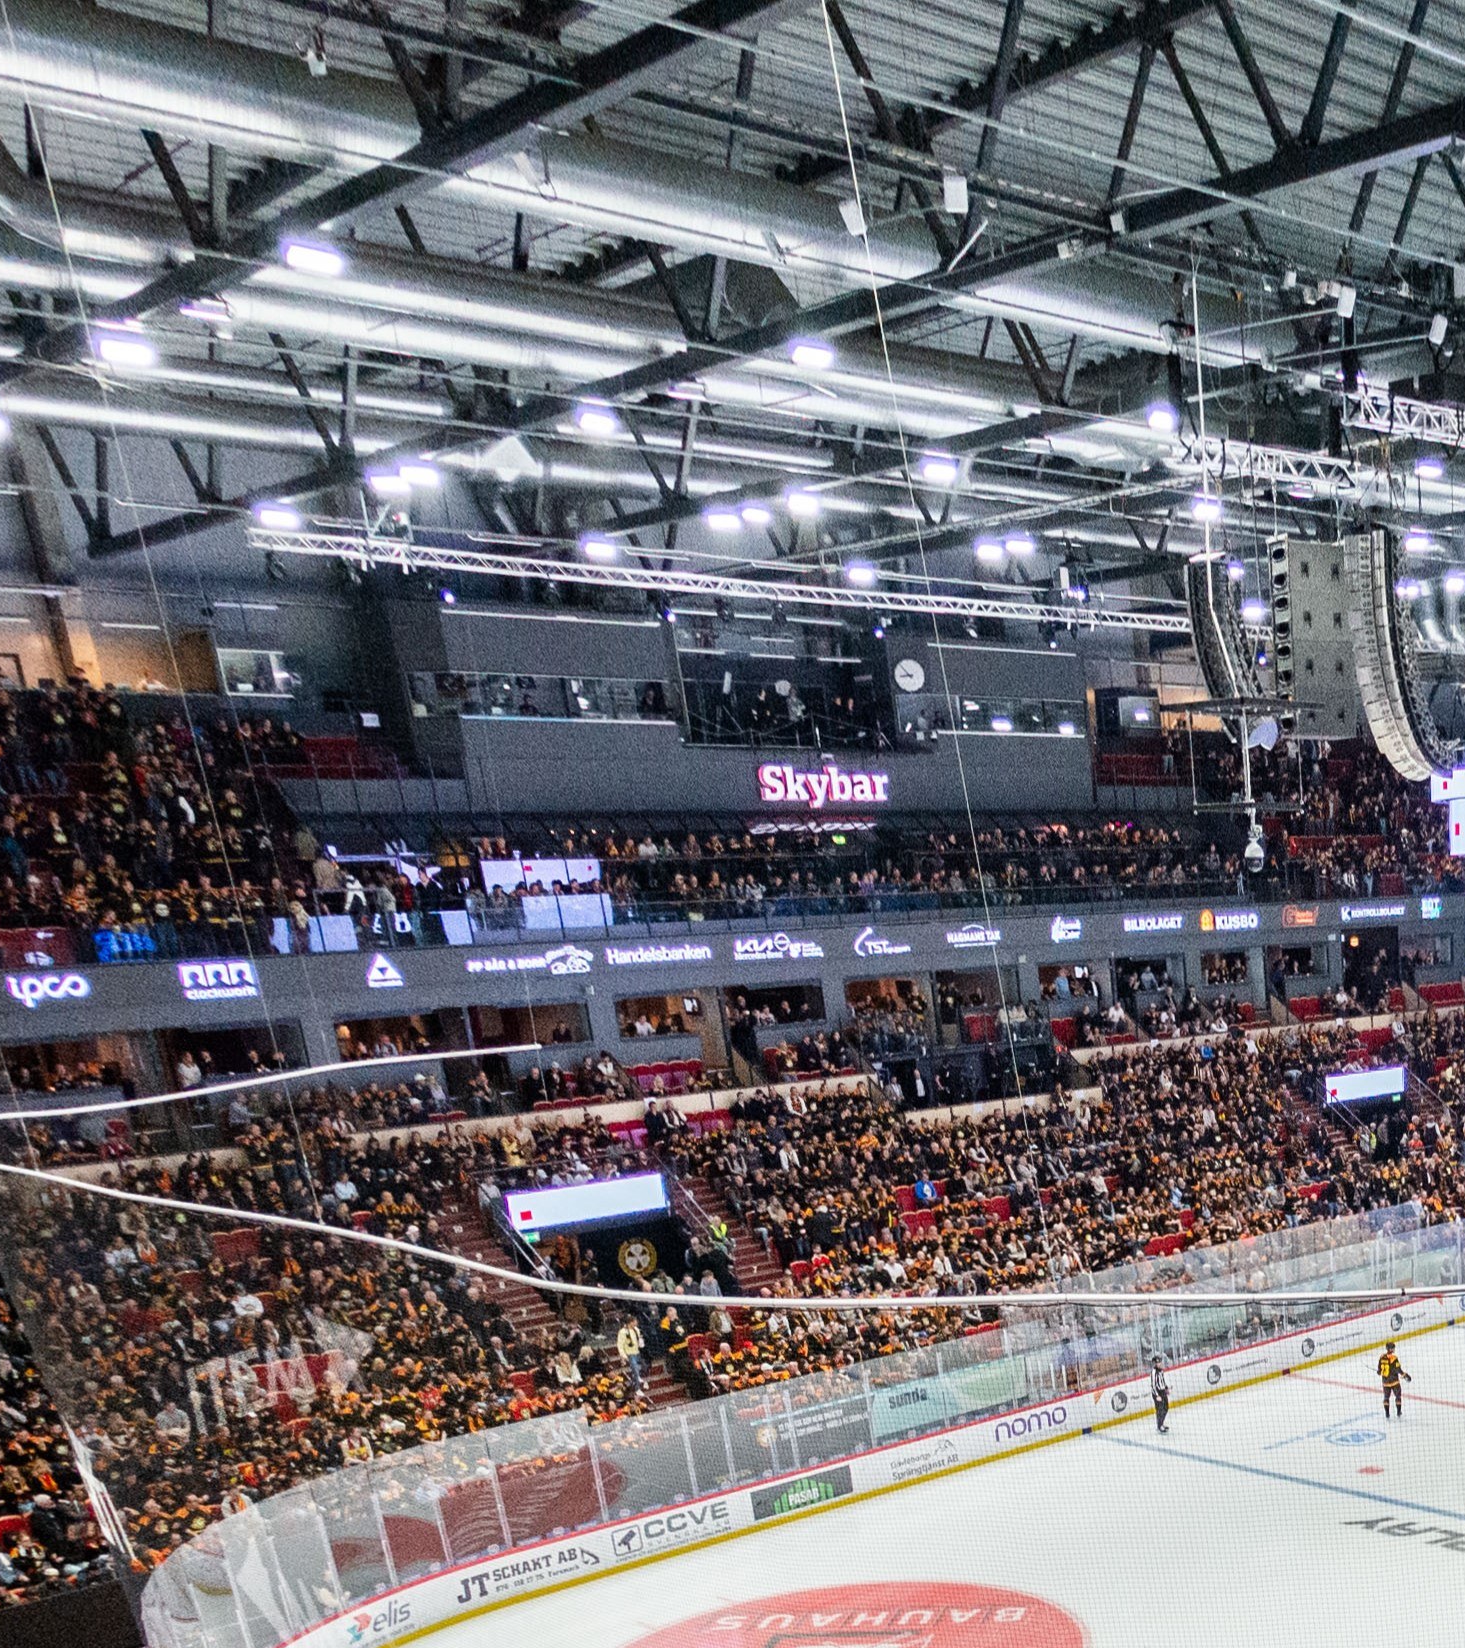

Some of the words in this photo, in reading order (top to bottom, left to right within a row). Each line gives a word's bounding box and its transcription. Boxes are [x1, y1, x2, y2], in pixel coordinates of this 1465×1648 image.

[758, 762, 889, 808] Skybar
[1124, 915, 1182, 932] BILBOLAGET
[606, 945, 712, 965] Handelsbanken
[736, 940, 773, 951] KIA
[864, 941, 889, 954] TST
[6, 974, 90, 1008] ipco
[186, 986, 258, 1000] clockwork
[995, 1406, 1067, 1443] nomo
[947, 1454, 959, 1467] AB
[643, 1501, 729, 1539] CCVE
[493, 1554, 553, 1582] SCHAKT
[557, 1548, 578, 1565] AB
[457, 1572, 490, 1604] JT
[372, 1601, 411, 1633] elis
[716, 1603, 1027, 1633] BAUHAUS
